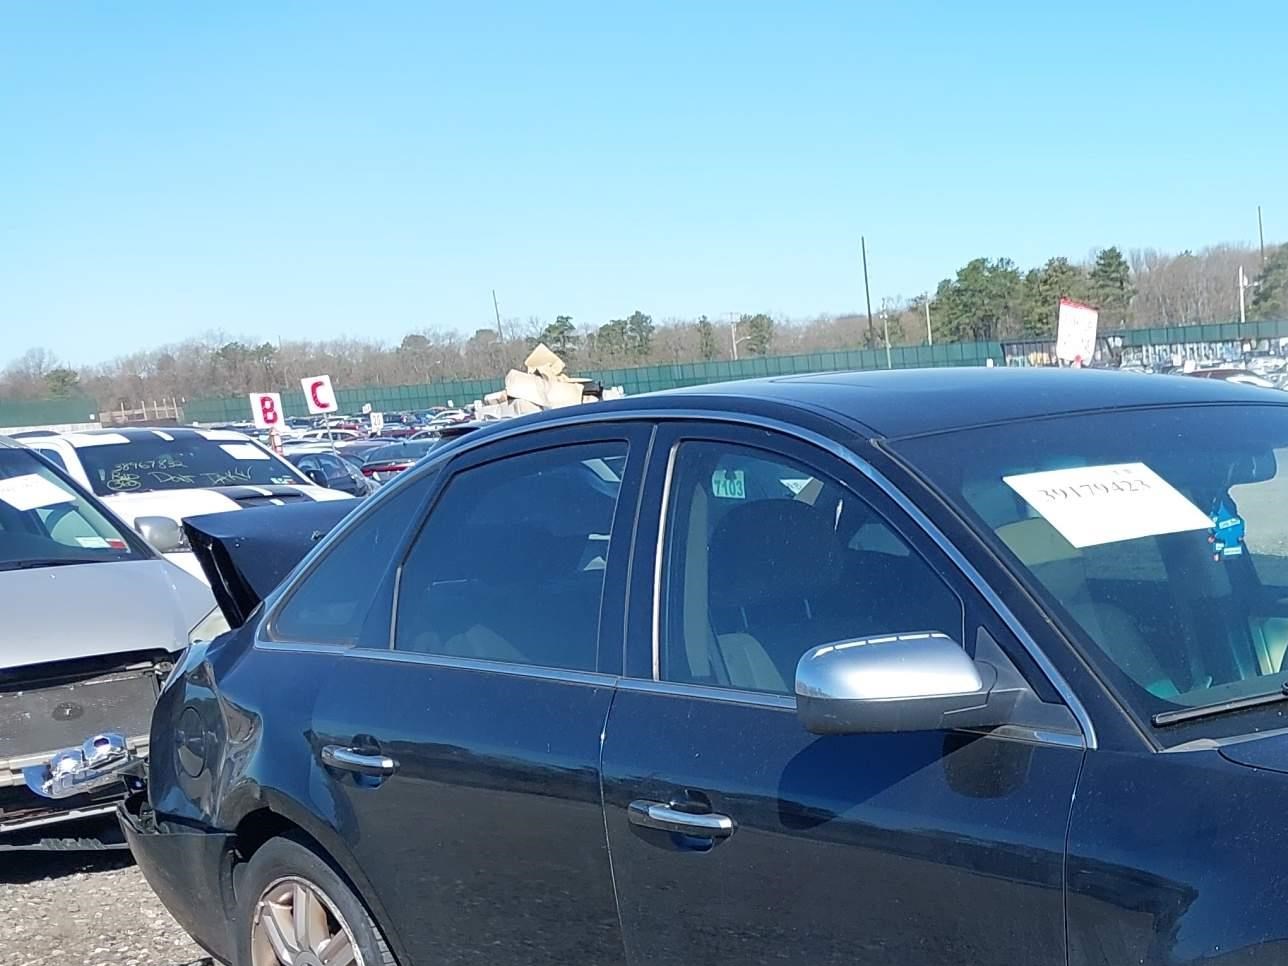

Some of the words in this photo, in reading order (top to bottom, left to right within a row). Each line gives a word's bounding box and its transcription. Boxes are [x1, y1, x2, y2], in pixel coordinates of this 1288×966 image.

[310, 380, 330, 408] C
[260, 396, 278, 424] B
[713, 479, 744, 497] 7103
[1037, 479, 1152, 501] 39179423
